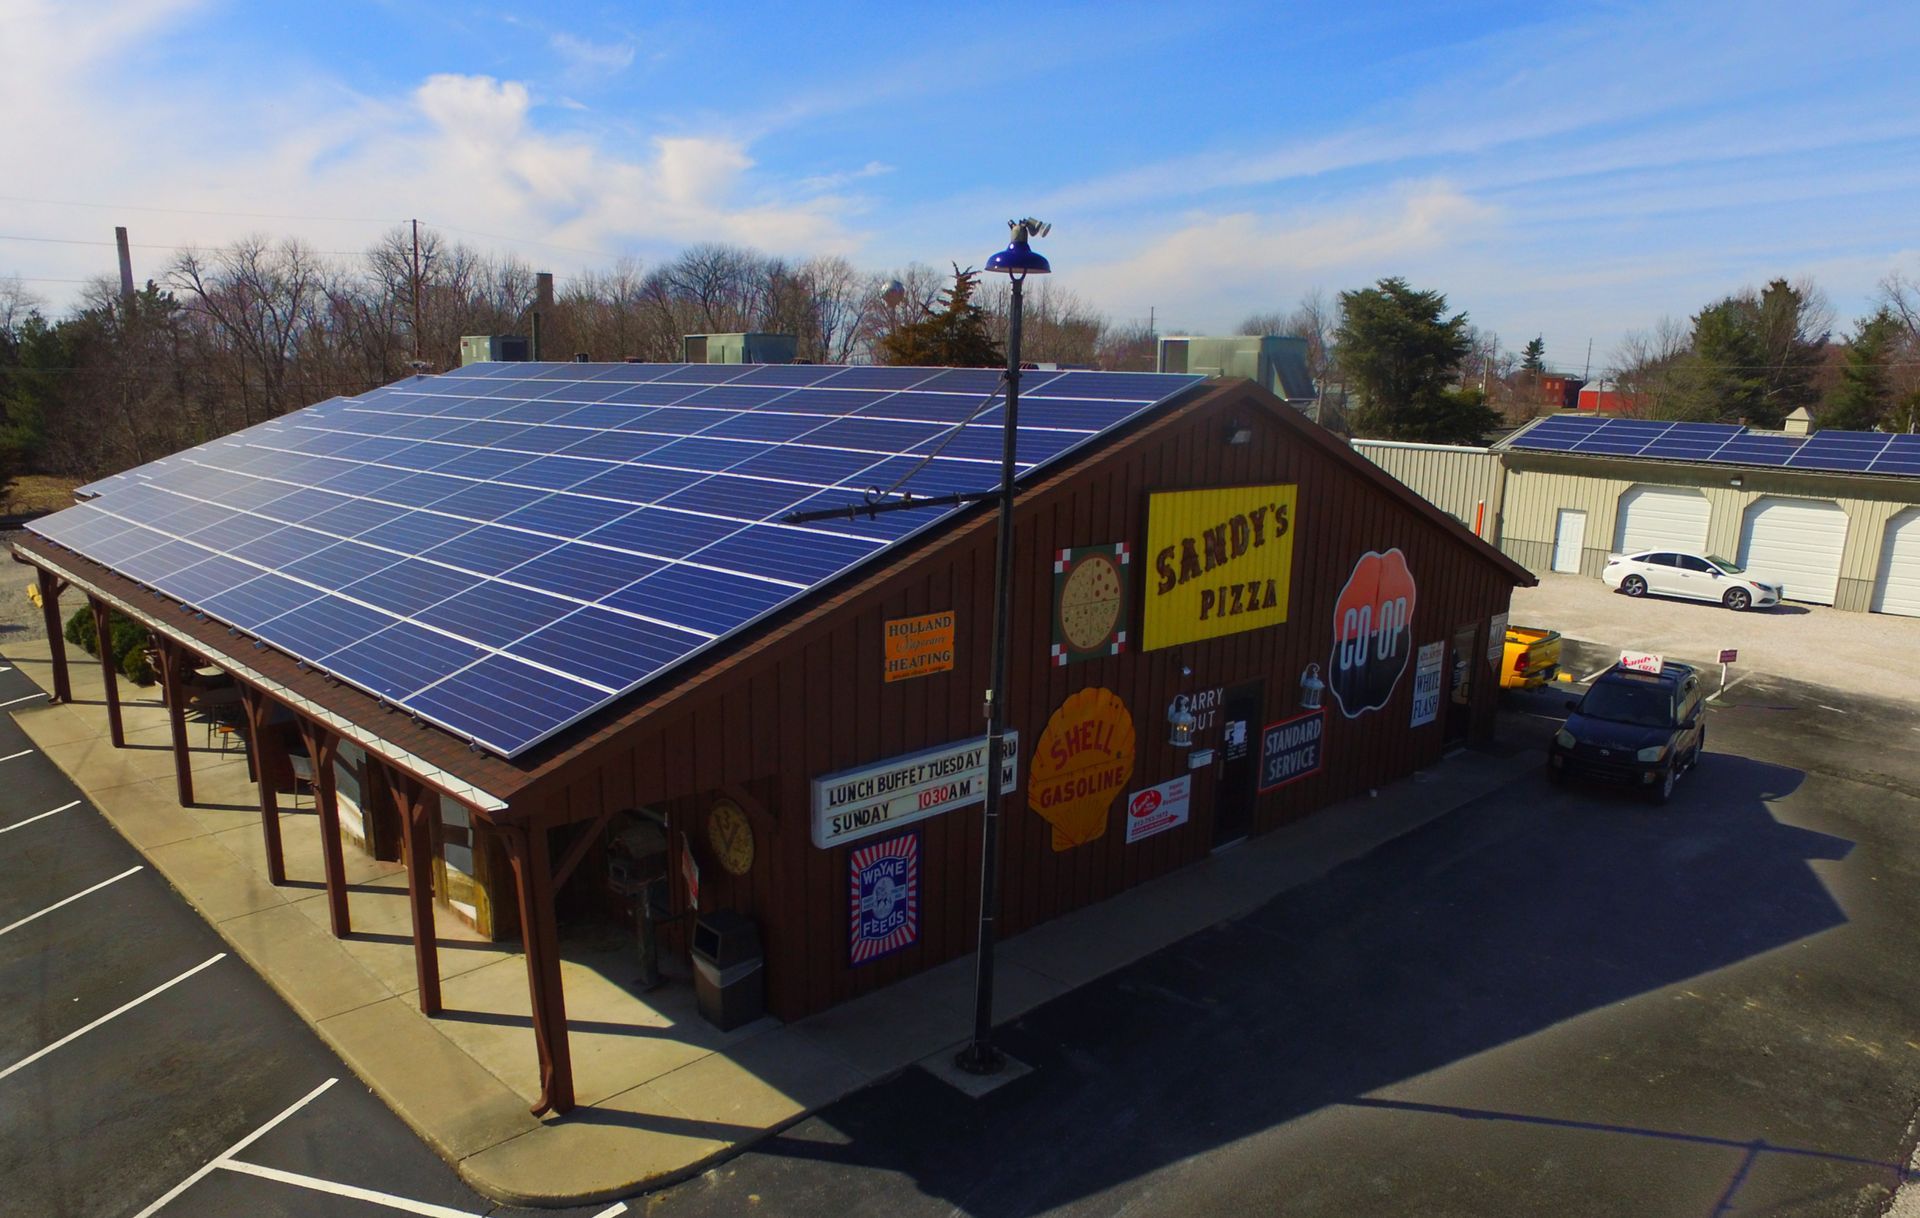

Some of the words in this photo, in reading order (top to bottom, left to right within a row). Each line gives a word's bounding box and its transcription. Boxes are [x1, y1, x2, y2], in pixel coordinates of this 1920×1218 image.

[1156, 503, 1289, 596] SANDY'S
[1200, 578, 1277, 621] PIZZA
[889, 616, 952, 637] HOLLAND
[1340, 597, 1407, 671] CO-OP
[889, 650, 951, 672] HEATING
[1413, 696, 1438, 718] FLASH
[1051, 720, 1114, 770] SHELL
[1265, 719, 1321, 756] STANDARD
[829, 779, 874, 806] LUNCH
[878, 765, 926, 792] BUFFET
[929, 750, 982, 778] TUESDAY
[1268, 745, 1316, 781] SERVICE
[1040, 766, 1124, 808] GASOLINE
[833, 802, 890, 833] SUNDAY
[862, 860, 905, 885] WAYNE
[863, 911, 904, 936] FEEDS
